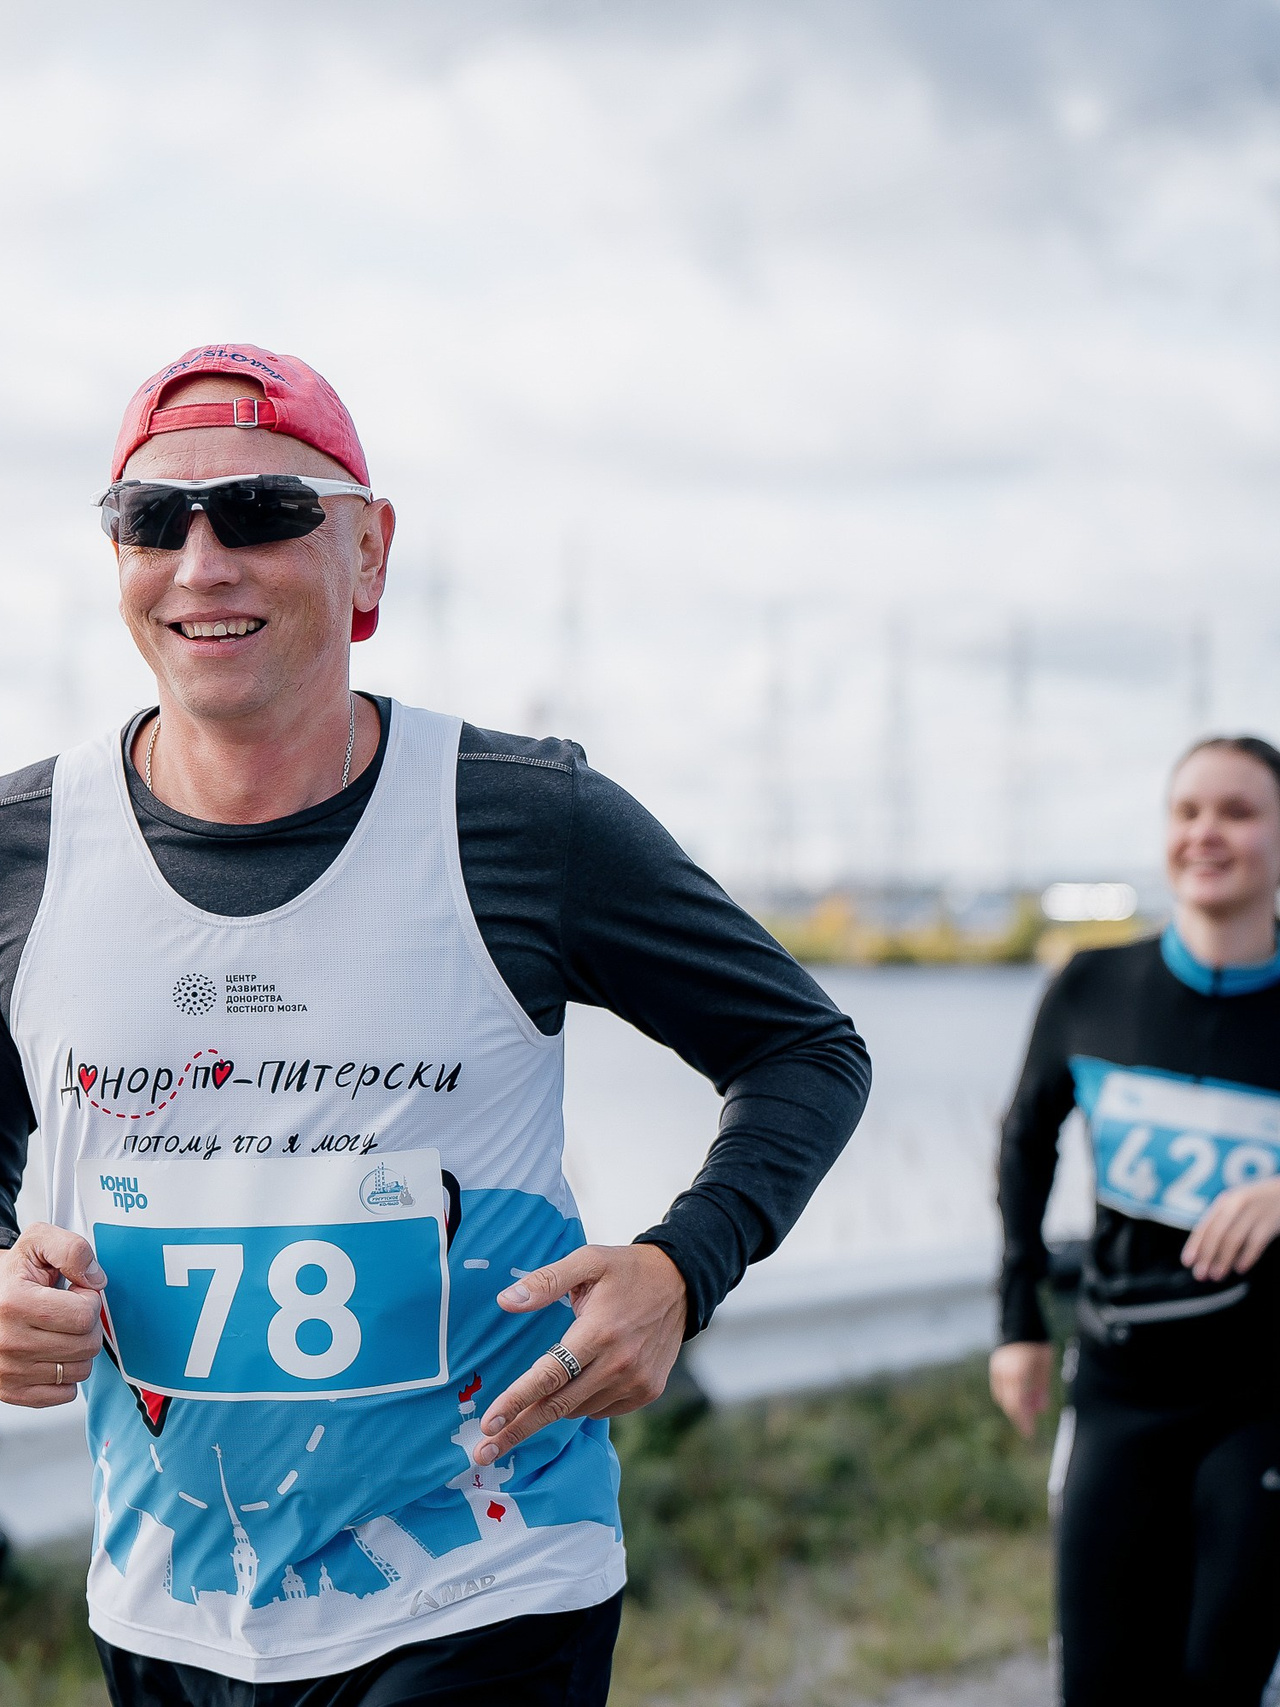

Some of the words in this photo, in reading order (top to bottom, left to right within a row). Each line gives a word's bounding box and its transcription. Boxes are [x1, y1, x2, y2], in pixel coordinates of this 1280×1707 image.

[225, 974, 257, 984] ЦЕНТР
[226, 984, 276, 993] РАЗВИТИЯ
[225, 994, 283, 1004] ДОНОРСТВА
[226, 1004, 275, 1014] КОСТНОГО
[277, 1004, 308, 1013] МОЗГА
[123, 1134, 222, 1160] потому
[232, 1134, 272, 1154] что
[282, 1132, 301, 1154] я
[311, 1132, 378, 1156] могу
[161, 1239, 362, 1380] 78
